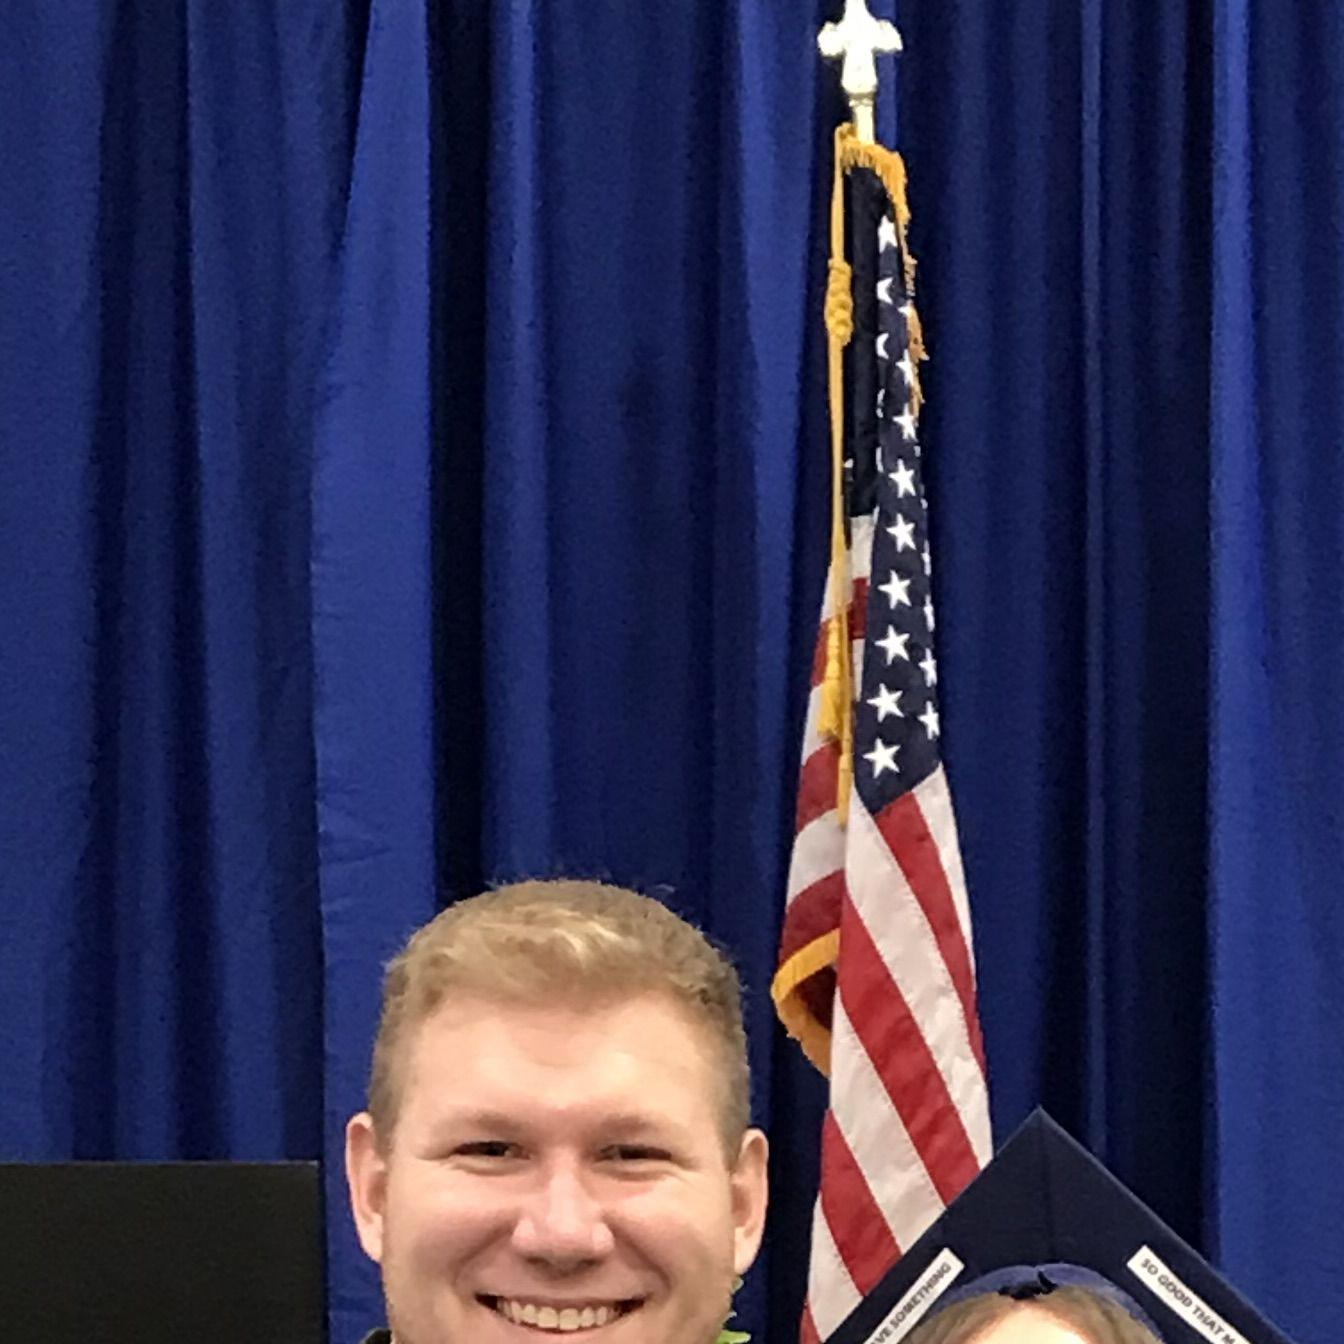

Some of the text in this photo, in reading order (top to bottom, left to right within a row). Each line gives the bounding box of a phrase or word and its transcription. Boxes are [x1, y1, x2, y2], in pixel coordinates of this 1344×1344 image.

[888, 1261, 952, 1330] SOMETHING
[1139, 1257, 1160, 1277] SO
[1155, 1272, 1195, 1309] GOOD
[1190, 1305, 1225, 1338] THAT
